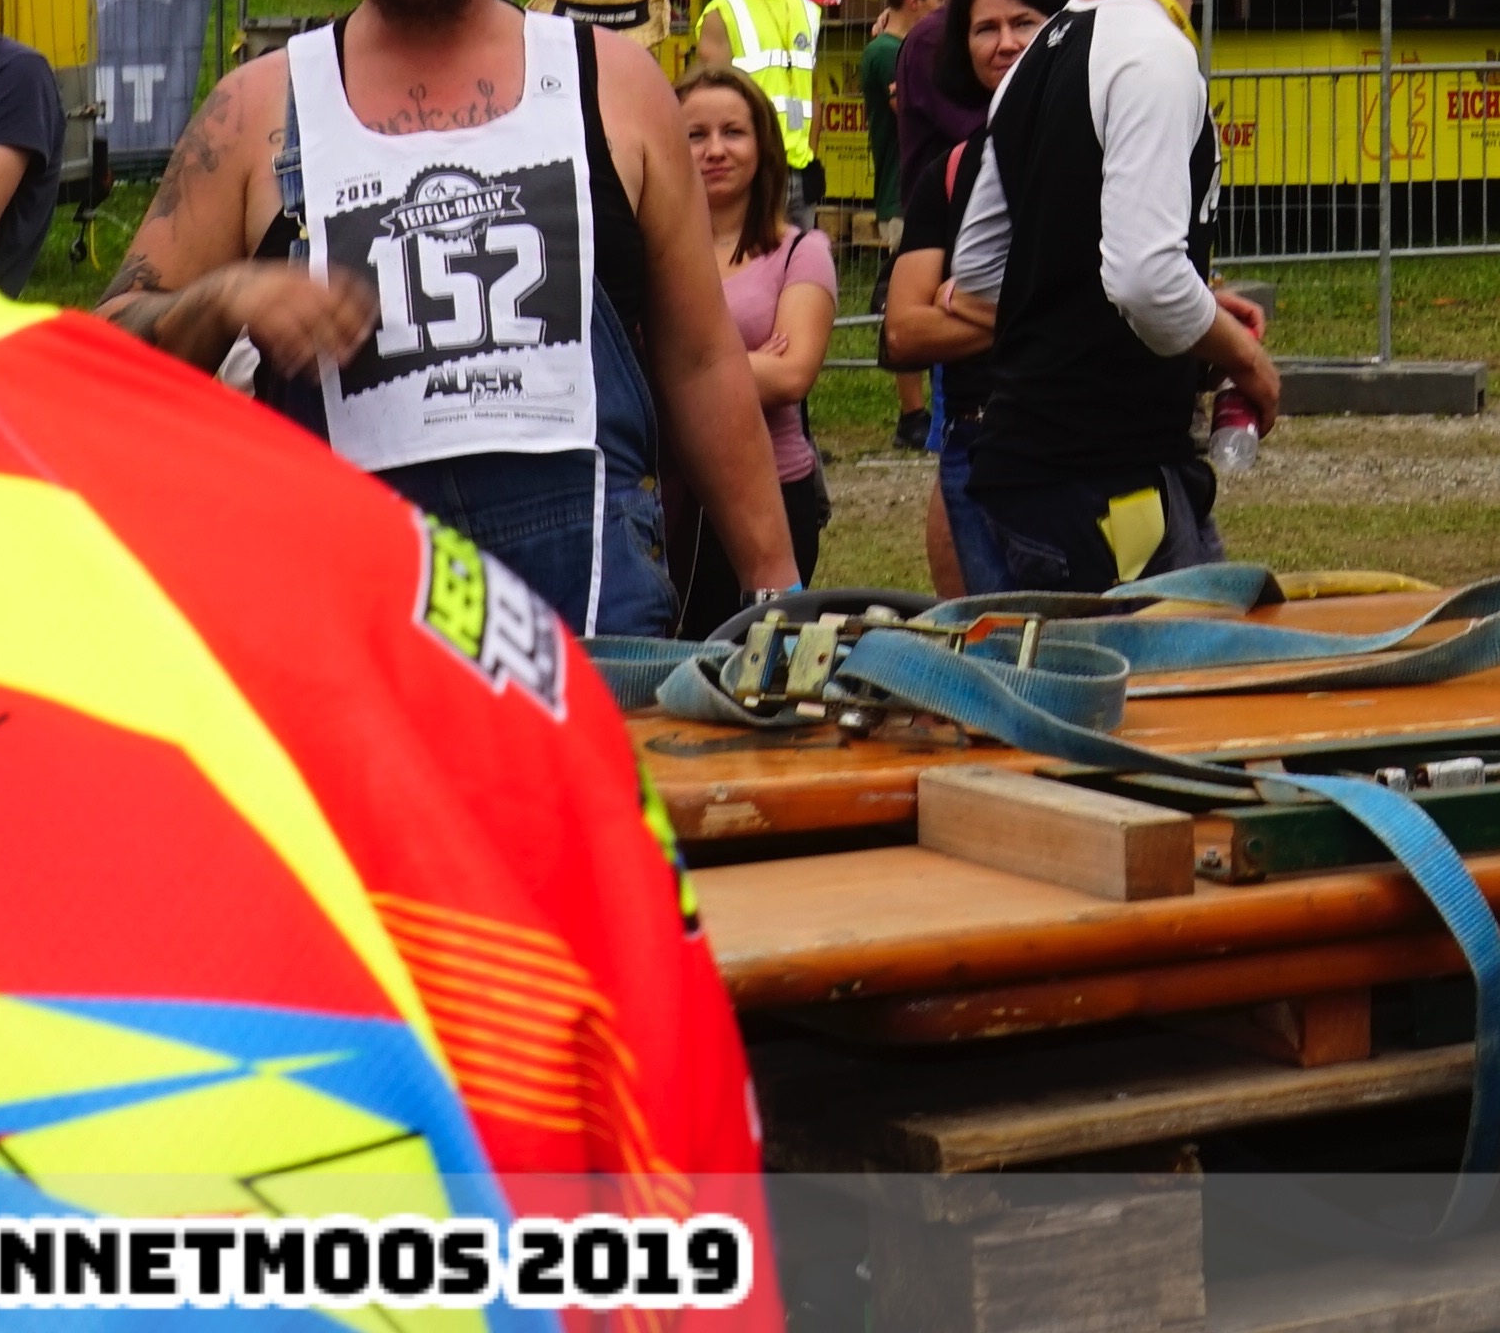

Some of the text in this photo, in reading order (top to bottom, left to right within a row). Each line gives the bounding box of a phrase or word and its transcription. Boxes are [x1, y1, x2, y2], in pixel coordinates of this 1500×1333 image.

[335, 180, 383, 208] 2019
[397, 190, 504, 230] TEFFLI-RALLY
[367, 223, 547, 360] 152
